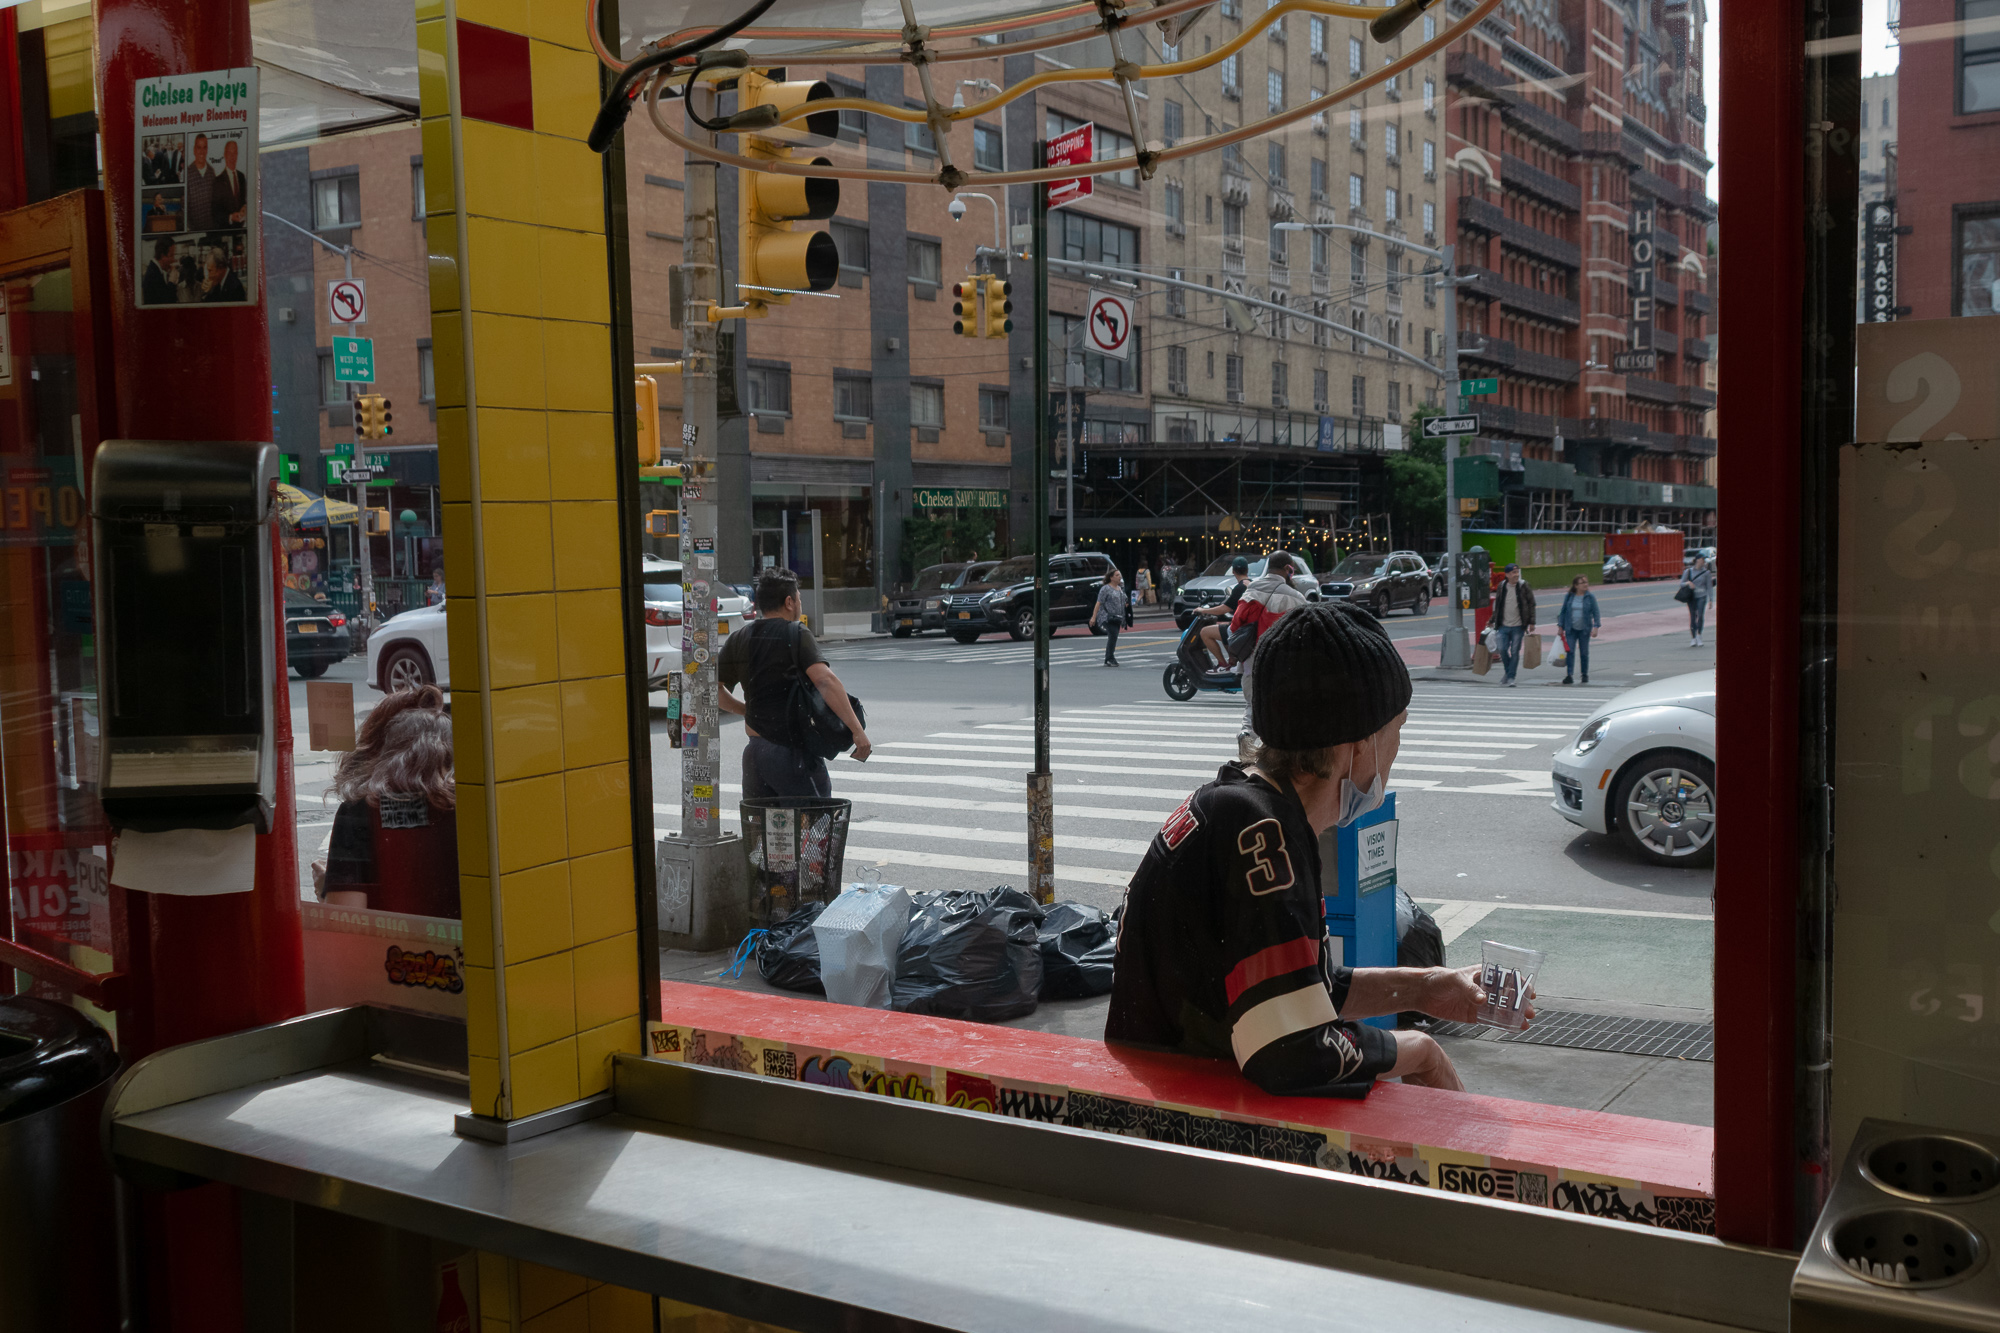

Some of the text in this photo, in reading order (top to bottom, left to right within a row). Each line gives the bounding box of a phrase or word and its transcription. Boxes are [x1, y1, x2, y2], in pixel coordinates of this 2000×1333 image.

[142, 79, 247, 108] Chelsea Papaya
[142, 106, 247, 128] Welcomes Mayor Bloomberg
[1056, 134, 1085, 155] STOPPING
[1633, 209, 1652, 351] HOTEL
[1875, 242, 1888, 323] TACOS
[1614, 354, 1655, 370] CHELSEA
[1470, 382, 1475, 393] 7
[683, 423, 696, 434] BEL
[1431, 420, 1471, 431] ONE WAY
[366, 455, 372, 465] W
[374, 456, 382, 465] 23
[328, 460, 347, 479] TD
[919, 490, 1002, 507] Chelsea SAVO HOTEL
[330, 512, 359, 522] SABRET
[1366, 831, 1386, 847] VISION
[1238, 818, 1295, 896] 3
[1367, 846, 1385, 861] TIMES
[79, 861, 109, 897] PUS
